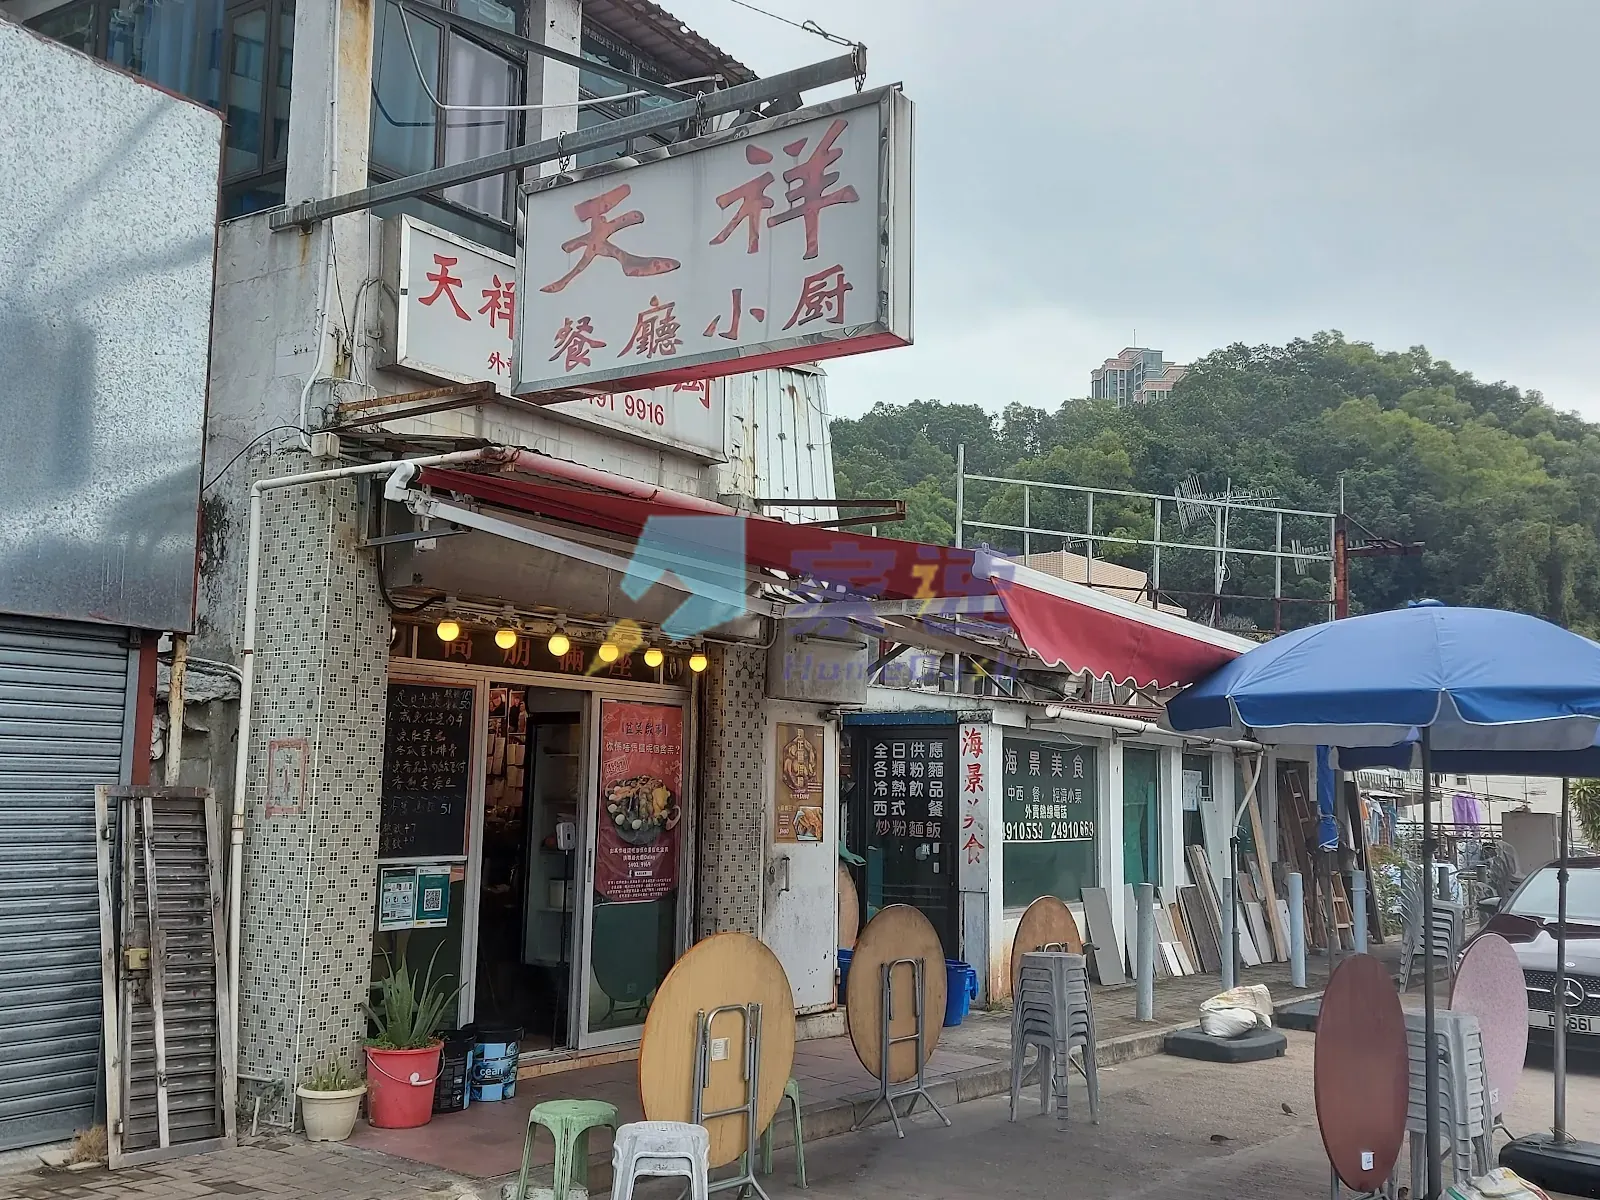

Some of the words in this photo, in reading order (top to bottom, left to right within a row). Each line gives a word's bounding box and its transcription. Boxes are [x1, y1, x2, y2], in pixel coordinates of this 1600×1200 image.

[540, 119, 860, 293] 天祥
[624, 394, 664, 426] 9916
[873, 741, 944, 759] 全日供應
[873, 760, 944, 778] 各類粉麵
[1005, 748, 1084, 779] 海景美食
[872, 780, 944, 798] 冷熱飲品
[1025, 803, 1068, 820] 外賣熱線電話
[875, 819, 942, 839] 炒粉麵飯
